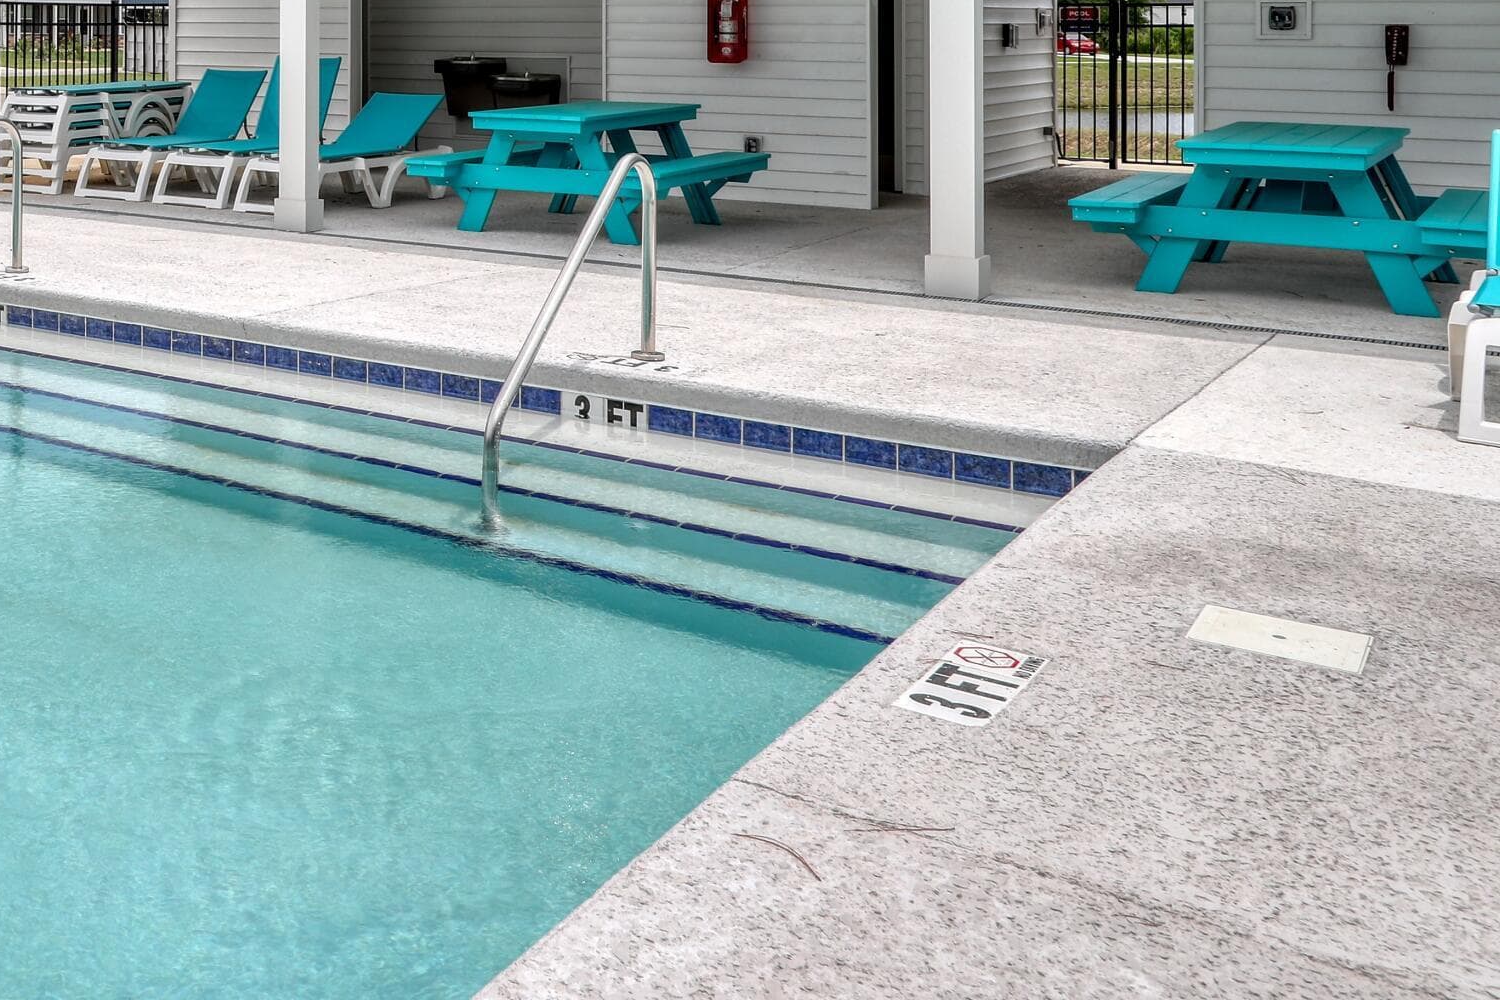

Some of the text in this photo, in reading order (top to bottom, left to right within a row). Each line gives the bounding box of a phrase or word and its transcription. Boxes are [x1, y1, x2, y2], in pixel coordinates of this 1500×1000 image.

[574, 395, 644, 427] 3 FT
[925, 662, 1020, 702] FT
[909, 693, 992, 719] 3
